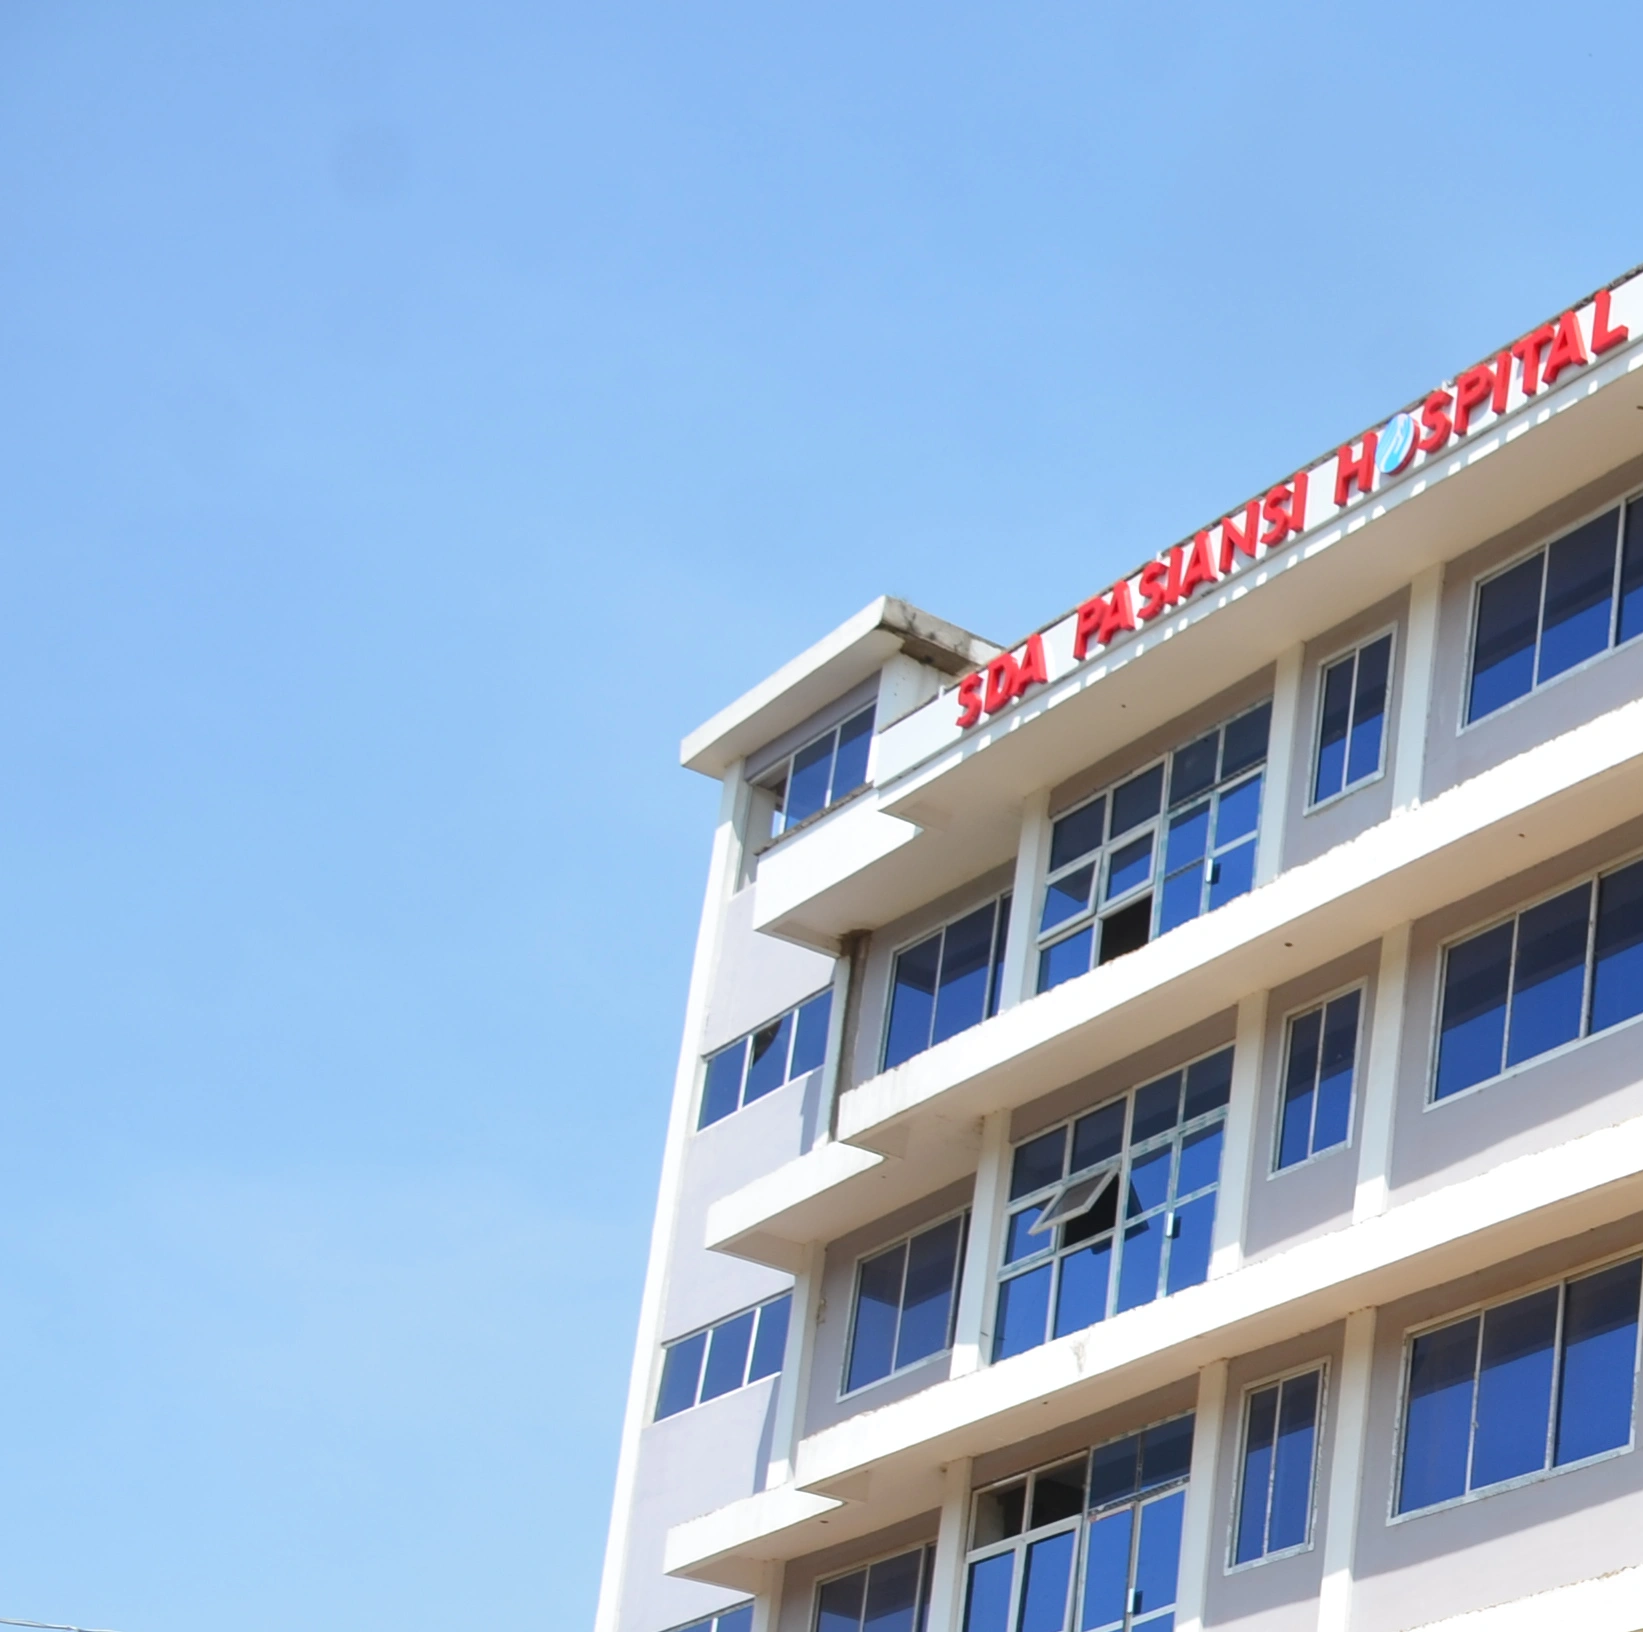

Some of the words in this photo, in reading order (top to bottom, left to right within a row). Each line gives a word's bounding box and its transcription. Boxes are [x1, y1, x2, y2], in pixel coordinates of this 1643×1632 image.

[956, 634, 1047, 729] SDA
[1074, 471, 1309, 661] PASIANSI
[1333, 289, 1629, 507] HOSPITAL
